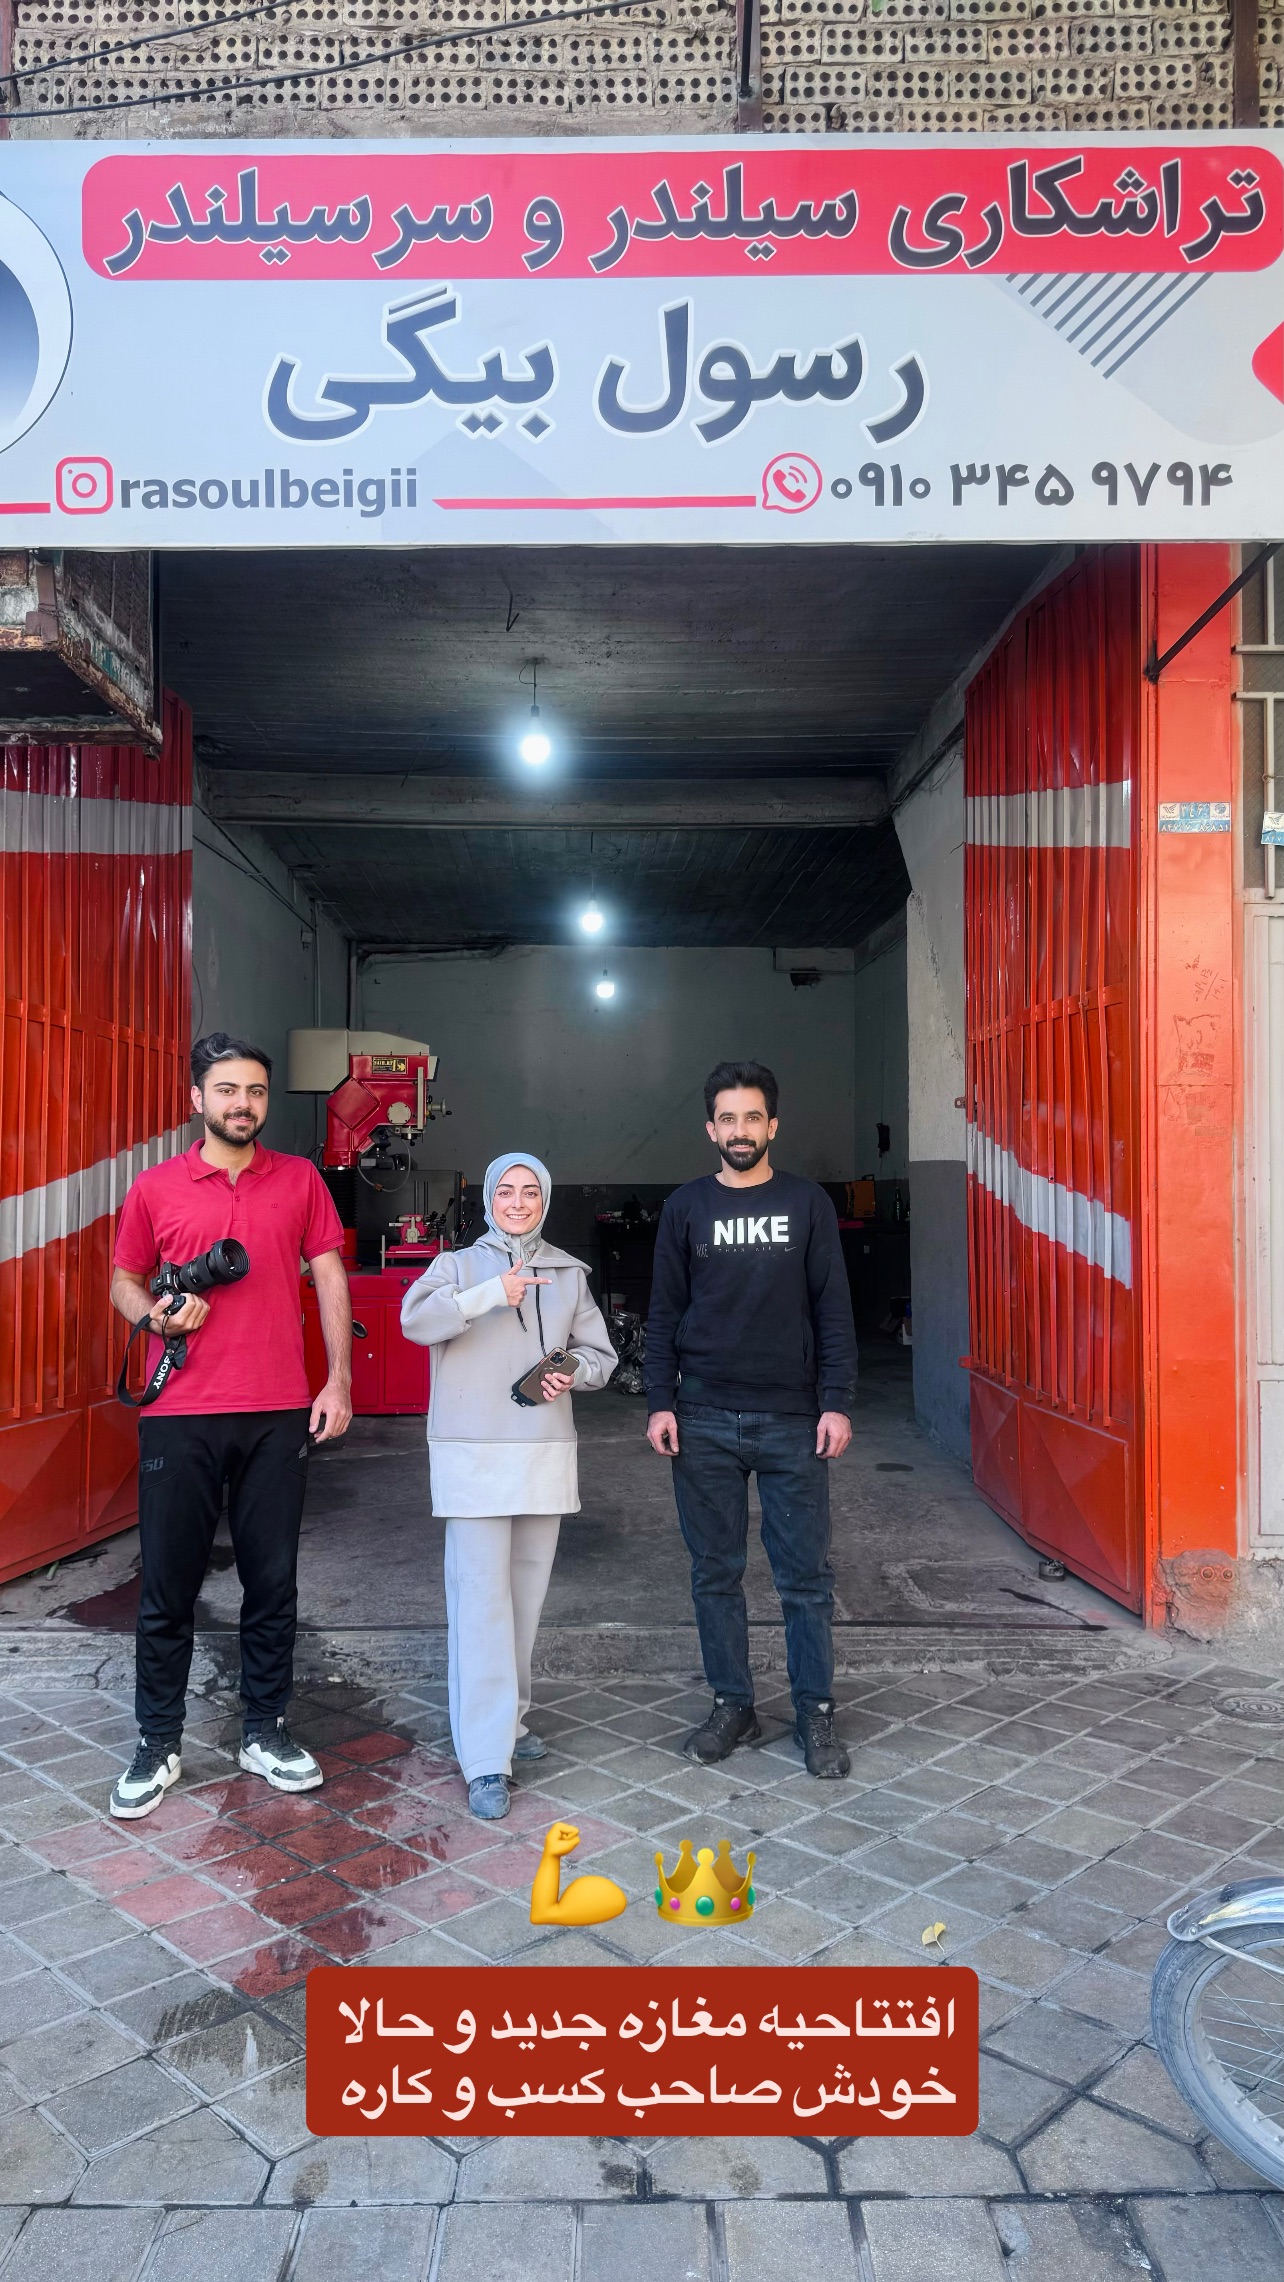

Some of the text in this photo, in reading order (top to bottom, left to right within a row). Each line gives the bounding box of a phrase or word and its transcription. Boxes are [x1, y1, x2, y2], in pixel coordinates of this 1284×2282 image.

[522, 196, 563, 271] و
[588, 162, 858, 273] سیلندر
[888, 156, 1265, 269] تراشکاری
[265, 284, 927, 446] رسول بیگی
[120, 469, 418, 516] rasoulbeigii
[831, 462, 1233, 507] ۰۹۱۰ ۳۴۵ ۹۷۹۴
[713, 1215, 790, 1246] NIKE
[153, 1355, 171, 1390] SONY
